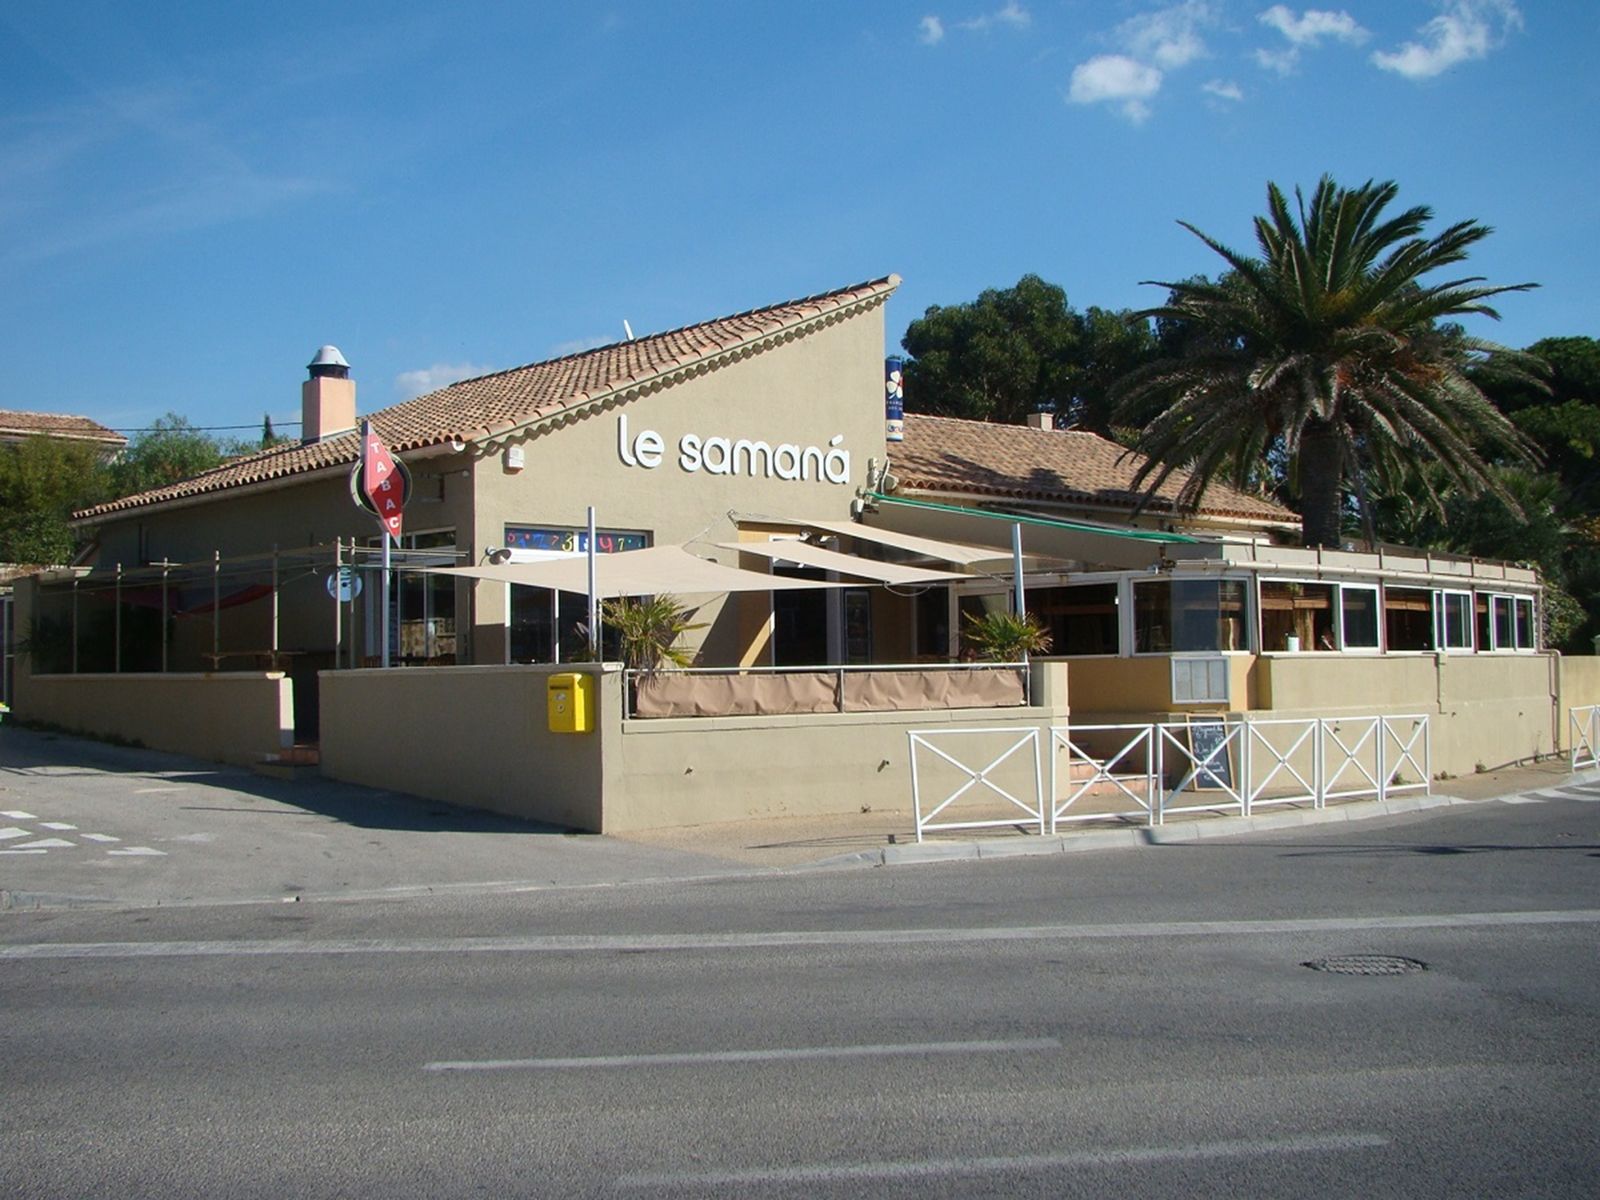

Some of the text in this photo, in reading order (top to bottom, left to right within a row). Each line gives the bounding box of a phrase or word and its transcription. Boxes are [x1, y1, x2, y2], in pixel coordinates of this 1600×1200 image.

[618, 413, 850, 484] le samaná
[370, 442, 400, 529] TABAC
[562, 532, 574, 552] 3
